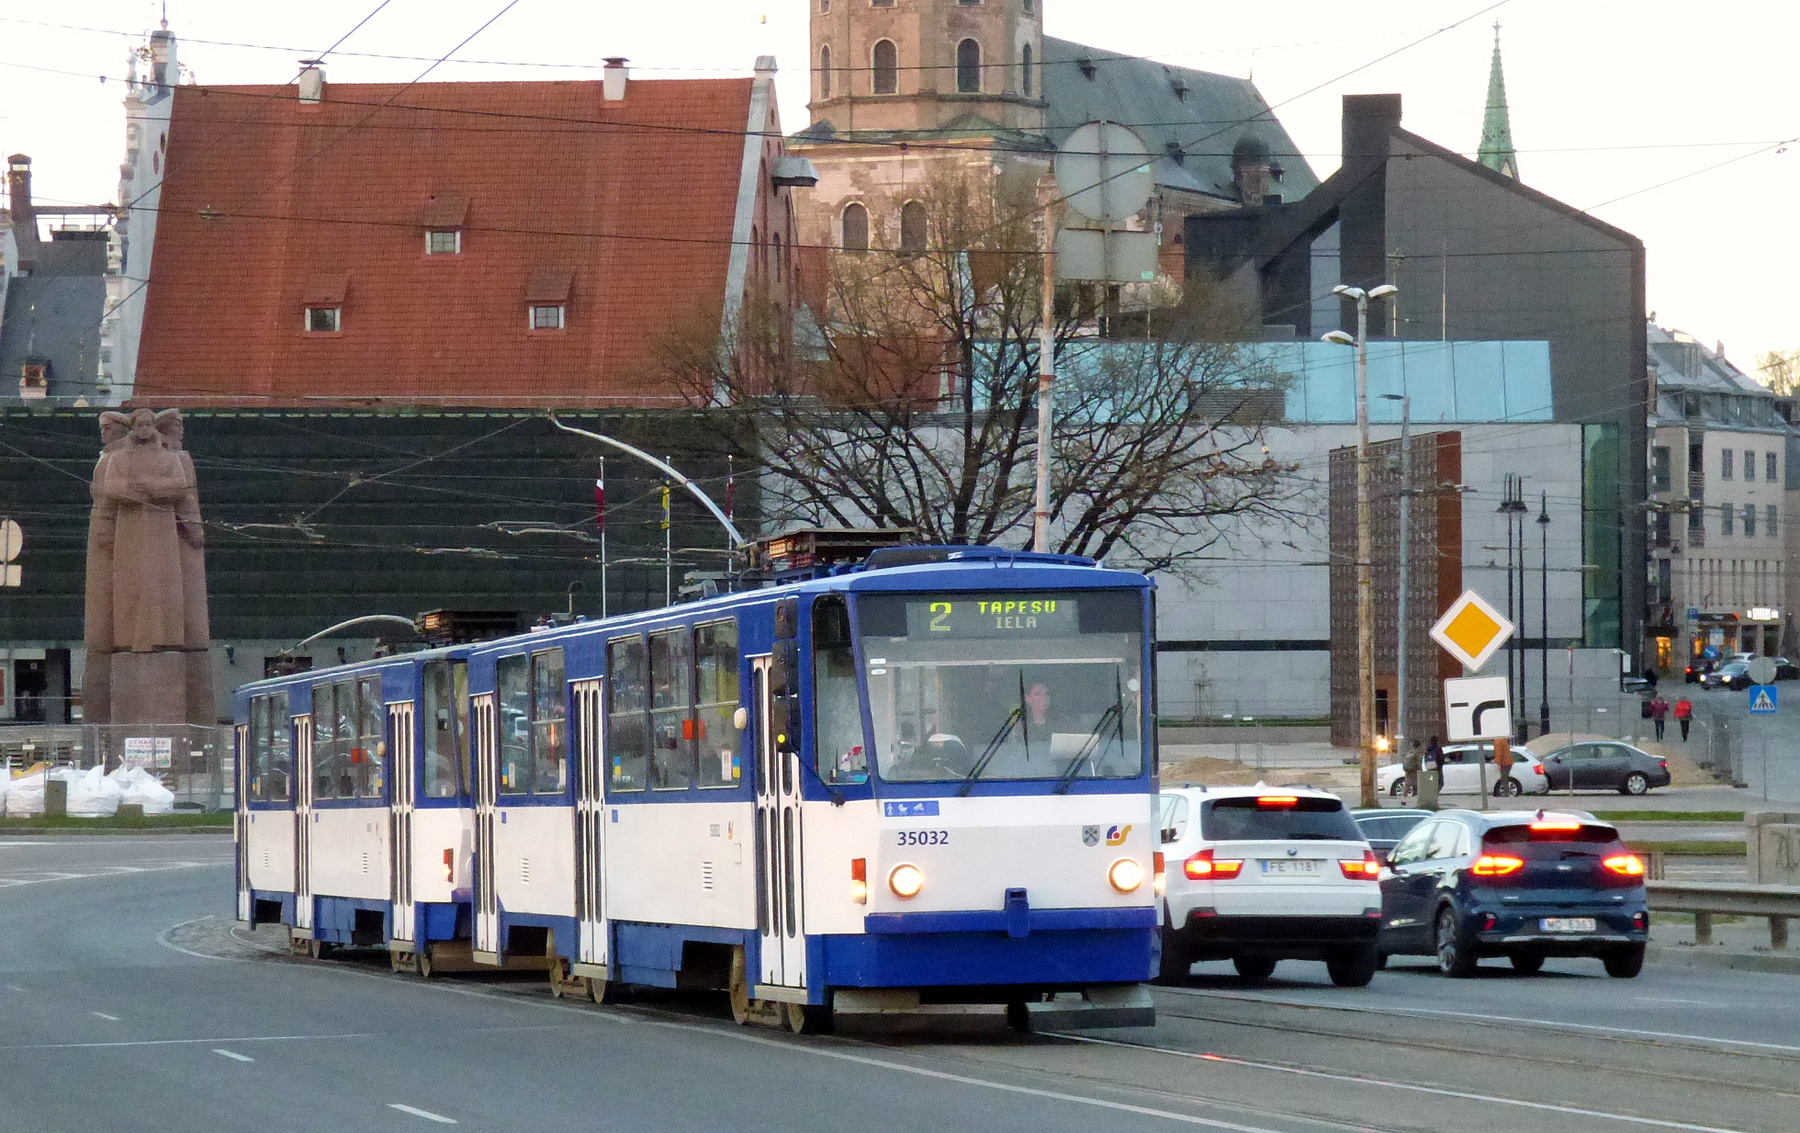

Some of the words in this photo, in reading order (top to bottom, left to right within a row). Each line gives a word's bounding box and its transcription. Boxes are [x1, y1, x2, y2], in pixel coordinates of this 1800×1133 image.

[978, 601, 1056, 614] TAPESU
[930, 602, 952, 631] 2
[996, 616, 1037, 629] IELA
[897, 830, 949, 846] 35032
